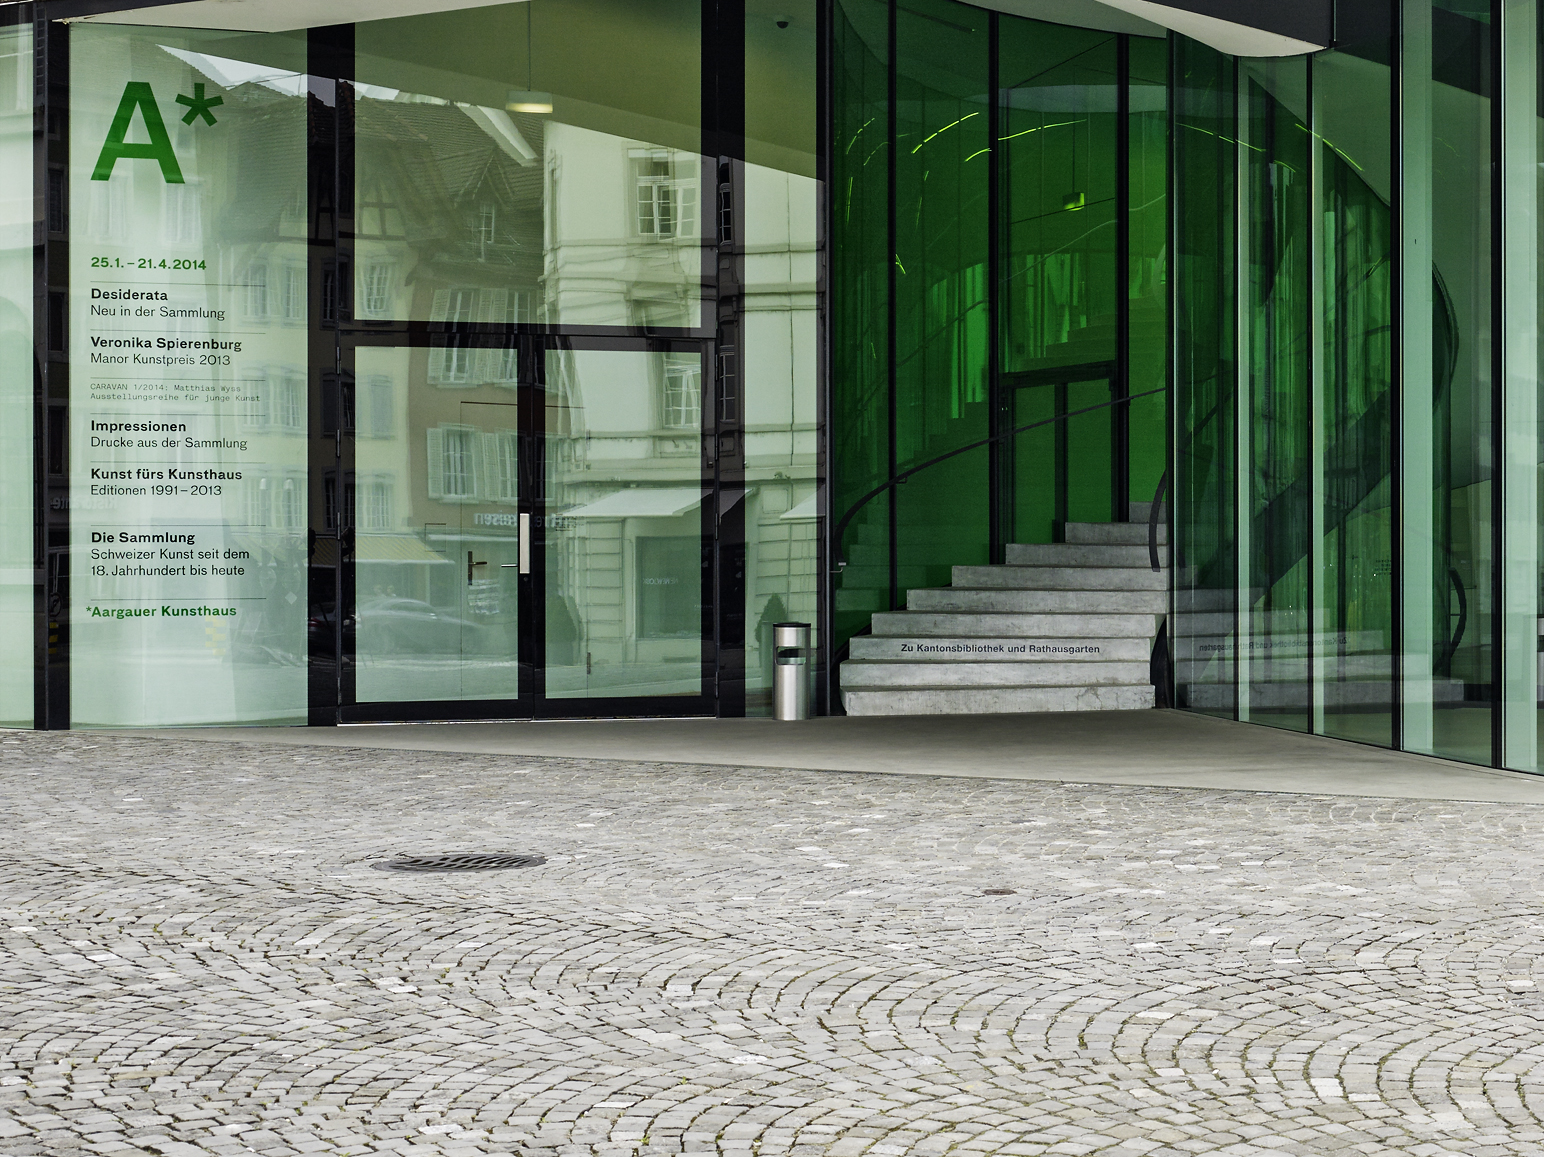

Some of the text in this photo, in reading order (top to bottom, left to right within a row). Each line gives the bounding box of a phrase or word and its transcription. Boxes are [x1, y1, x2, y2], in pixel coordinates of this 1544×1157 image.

[91, 288, 168, 301] Desiderata
[90, 305, 225, 321] Neu in der Sammlung
[90, 336, 242, 352] Veronika Spierenburg
[90, 353, 231, 366] Manor Kunstpreis 2013
[90, 383, 128, 391] CARAVAN
[174, 384, 216, 392] Matthias
[220, 385, 241, 393] Wyss
[90, 393, 179, 402] Ausstellungsreihe
[184, 393, 199, 401] für
[205, 394, 231, 403] junge
[91, 420, 186, 433] Impressionen
[91, 437, 248, 451] Drucke aus der Sammlung
[91, 468, 243, 480] Kunst fürs Kunsthaus
[91, 484, 147, 495] Editionen
[91, 532, 195, 545] Die Sammlung
[91, 548, 250, 559] Schweizer Kunst seit dem
[91, 565, 245, 576] 18. Jahrhundert bis heute
[161, 605, 237, 617] Kunsthaus
[901, 644, 1100, 655] Zu Kantonsbibliothek und Rathausgarten
